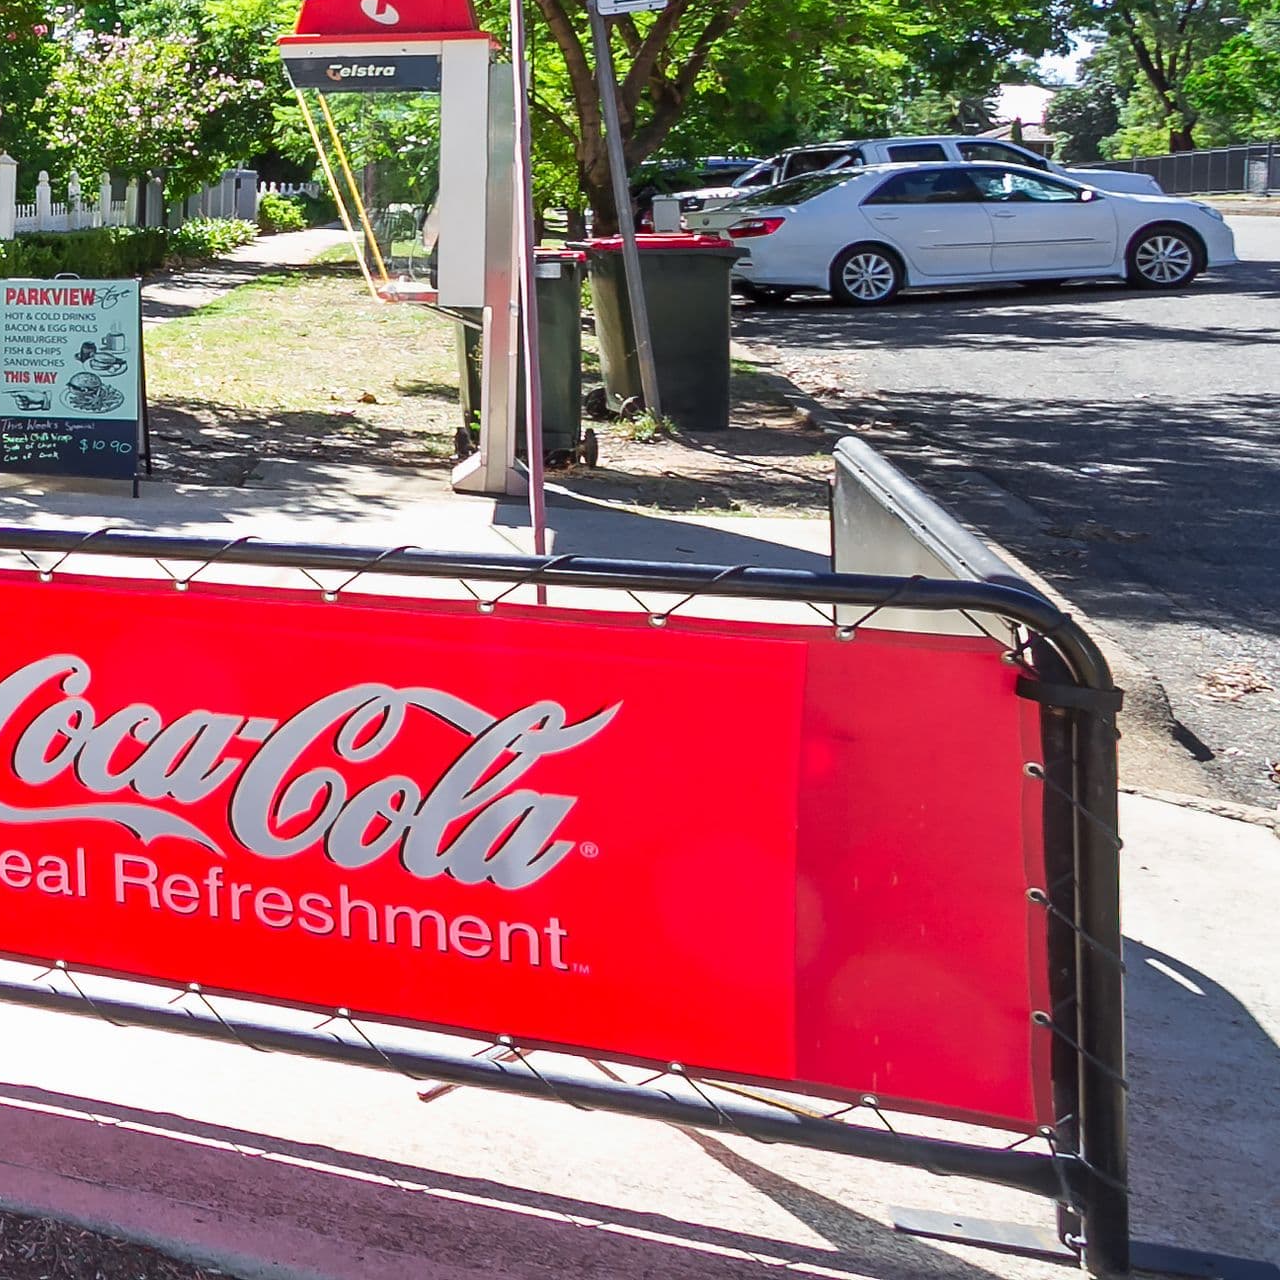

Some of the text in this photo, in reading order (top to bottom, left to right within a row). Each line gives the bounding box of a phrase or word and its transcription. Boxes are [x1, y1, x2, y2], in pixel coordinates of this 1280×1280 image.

[326, 64, 396, 81] Telstra
[5, 287, 96, 306] PARKVIEW
[4, 312, 24, 321] HOT
[34, 313, 60, 321] COLD
[62, 313, 97, 321] DRINKS
[4, 324, 98, 333] BACON & EGG ROLLS
[4, 335, 68, 344] HAMBURGERS
[4, 347, 61, 355] FISH & CHIPS
[3, 358, 65, 367] SANDWICHES
[4, 370, 58, 384] THIS WAY
[1, 418, 24, 432] This
[114, 851, 569, 971] Refreshment
